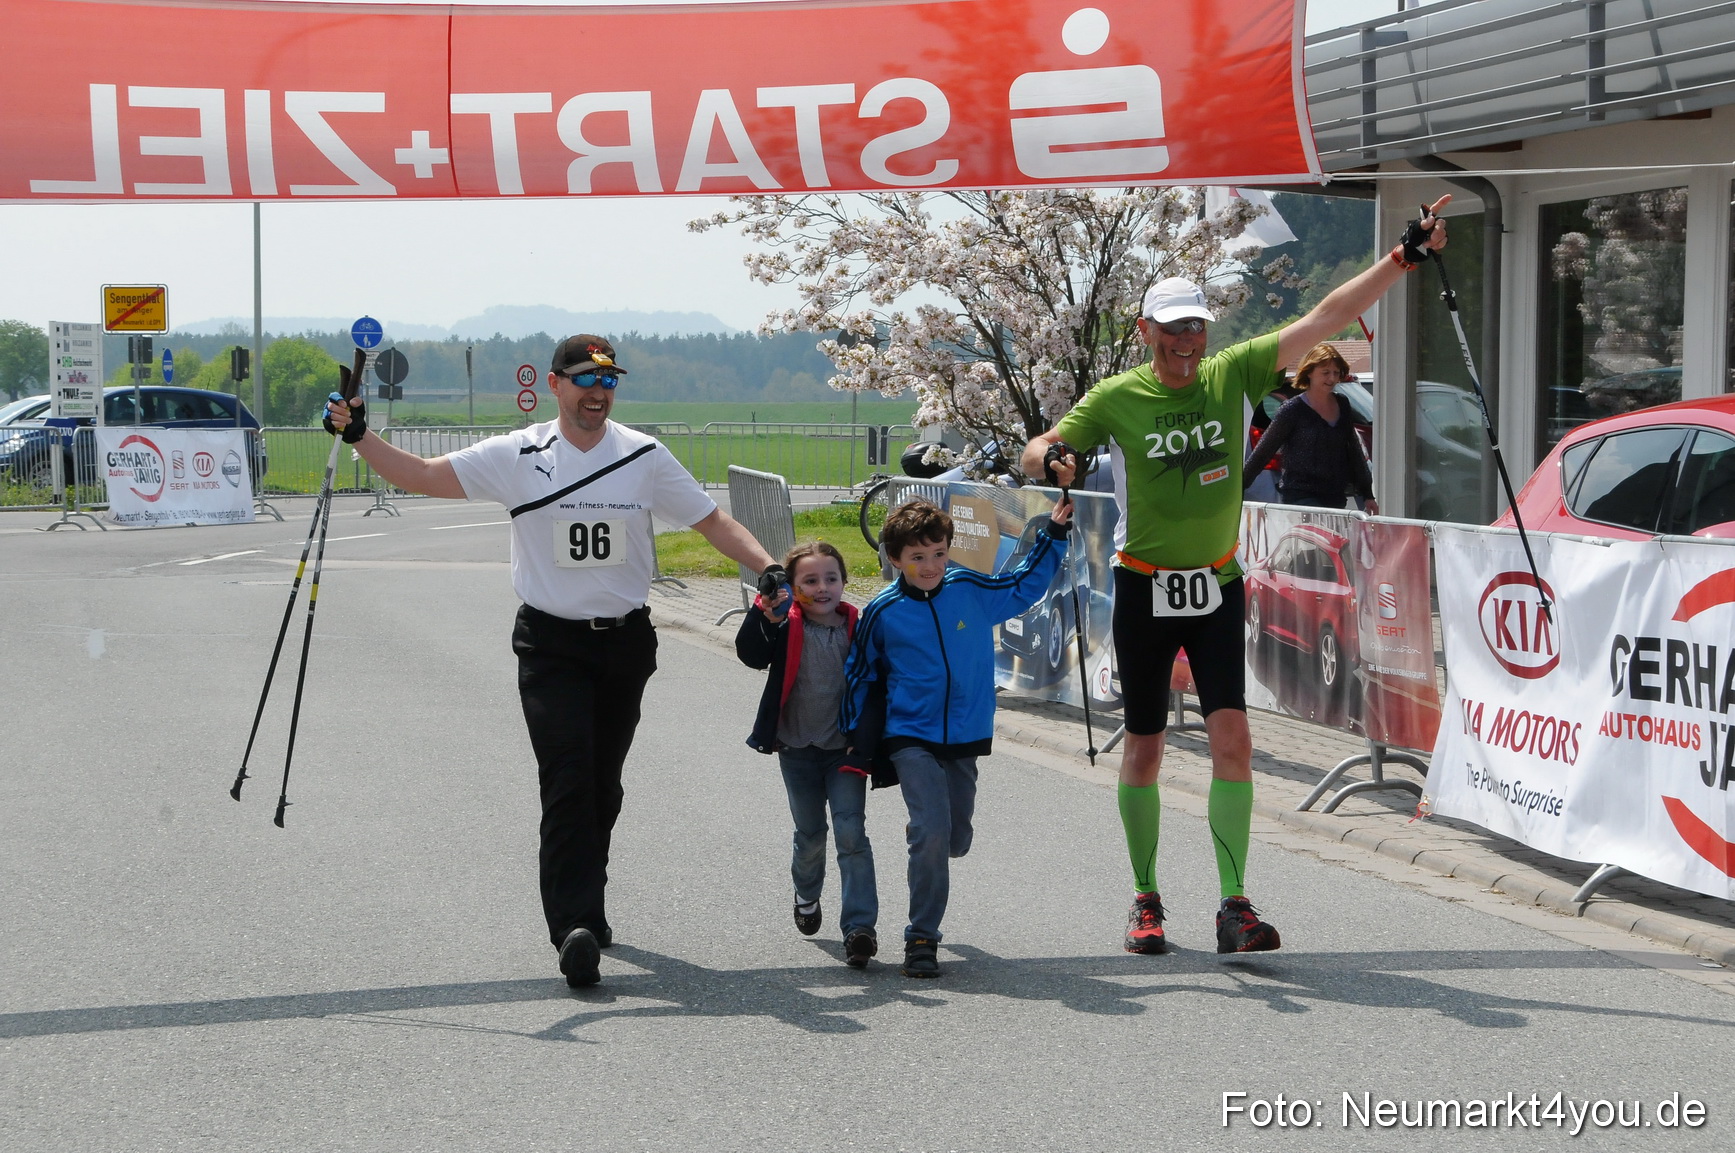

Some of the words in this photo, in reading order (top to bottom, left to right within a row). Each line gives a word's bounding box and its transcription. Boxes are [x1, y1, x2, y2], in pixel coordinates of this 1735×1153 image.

[110, 293, 160, 306] Sengenthal
[521, 371, 533, 381] 60
[1155, 411, 1205, 429] FÜRTH
[1145, 421, 1225, 458] 2012
[107, 451, 151, 467] GERHART
[196, 458, 211, 471] KIA
[170, 482, 189, 490] SEAT
[569, 522, 611, 561] 96
[1167, 572, 1209, 610] 80
[1377, 625, 1406, 637] SEAT
[1492, 597, 1553, 656] KIA
[1486, 706, 1582, 767] MOTORS
[1599, 711, 1701, 751] AUTOHAUS
[1480, 767, 1499, 797] Pow
[1500, 779, 1510, 801] to
[1511, 780, 1563, 817] Surprise
